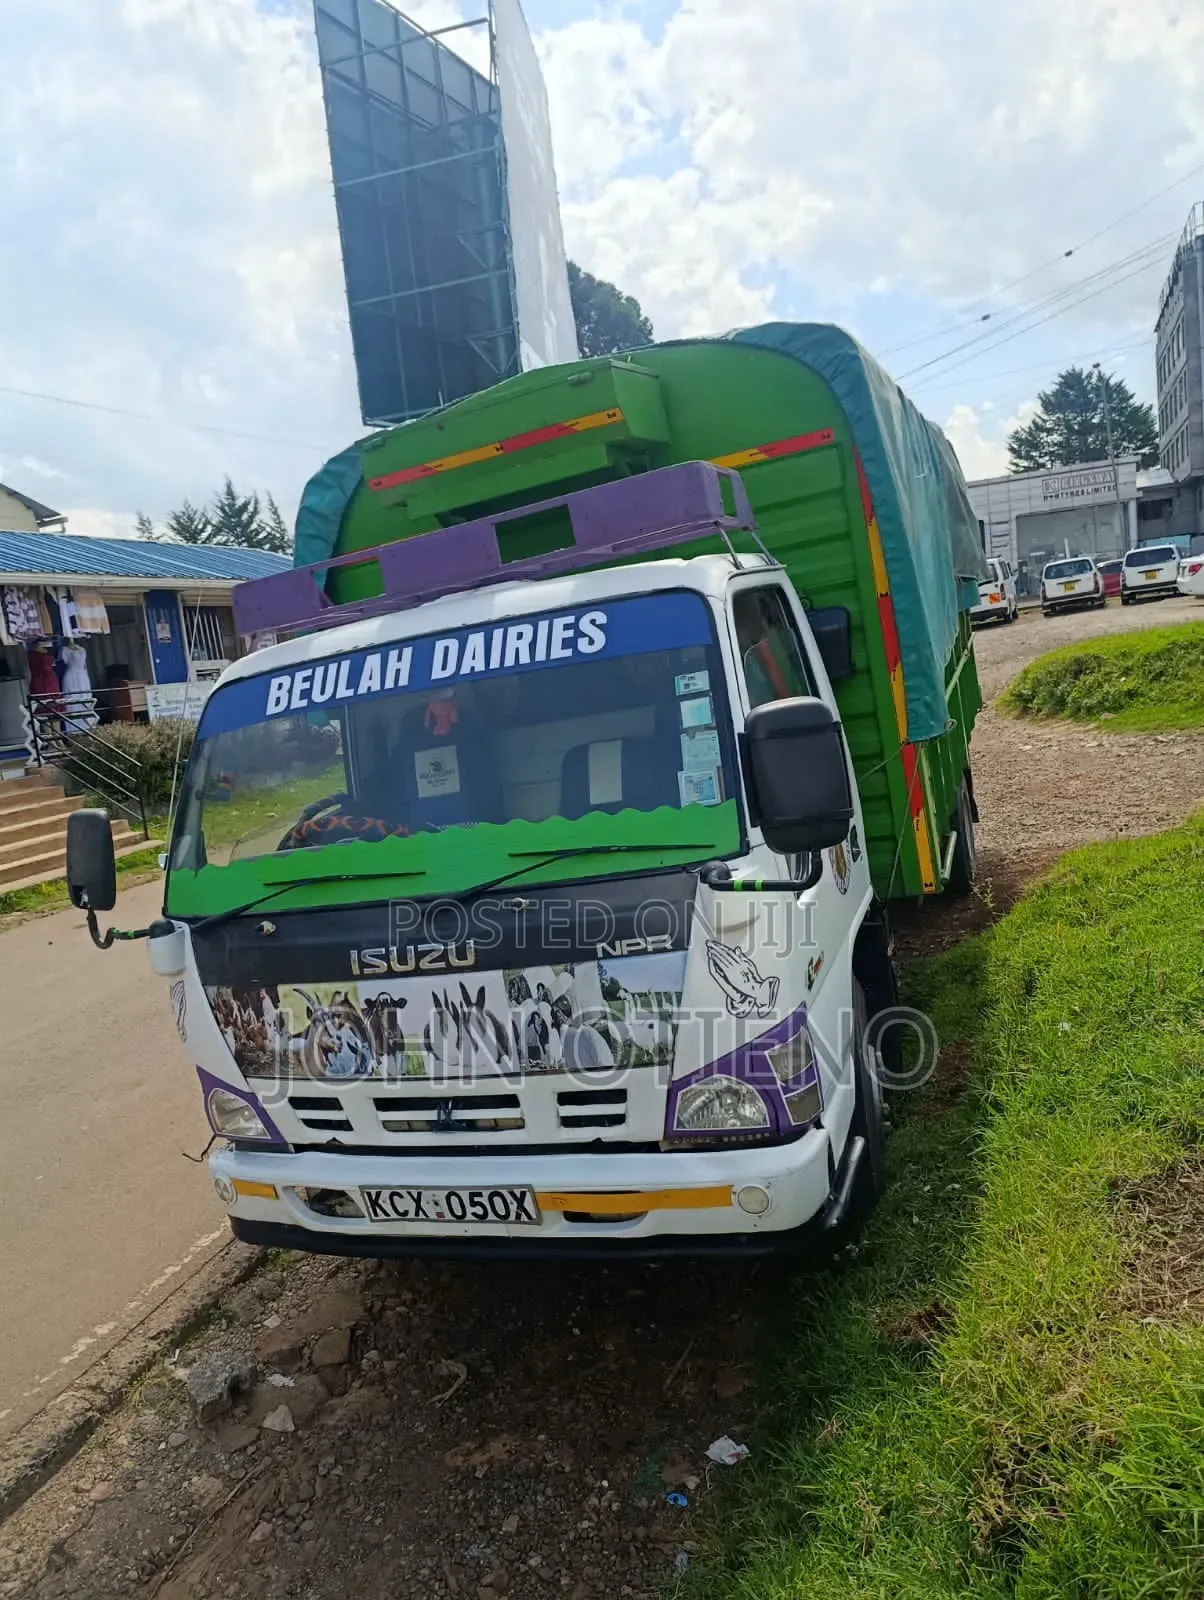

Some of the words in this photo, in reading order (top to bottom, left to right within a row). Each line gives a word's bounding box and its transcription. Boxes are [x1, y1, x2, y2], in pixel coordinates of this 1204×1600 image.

[265, 647, 413, 717] BEULAH
[430, 610, 607, 681] DAIRIES
[350, 940, 476, 976] ISUZU
[596, 933, 673, 958] NPR
[365, 1190, 430, 1218] KCX
[444, 1190, 534, 1221] 050X
